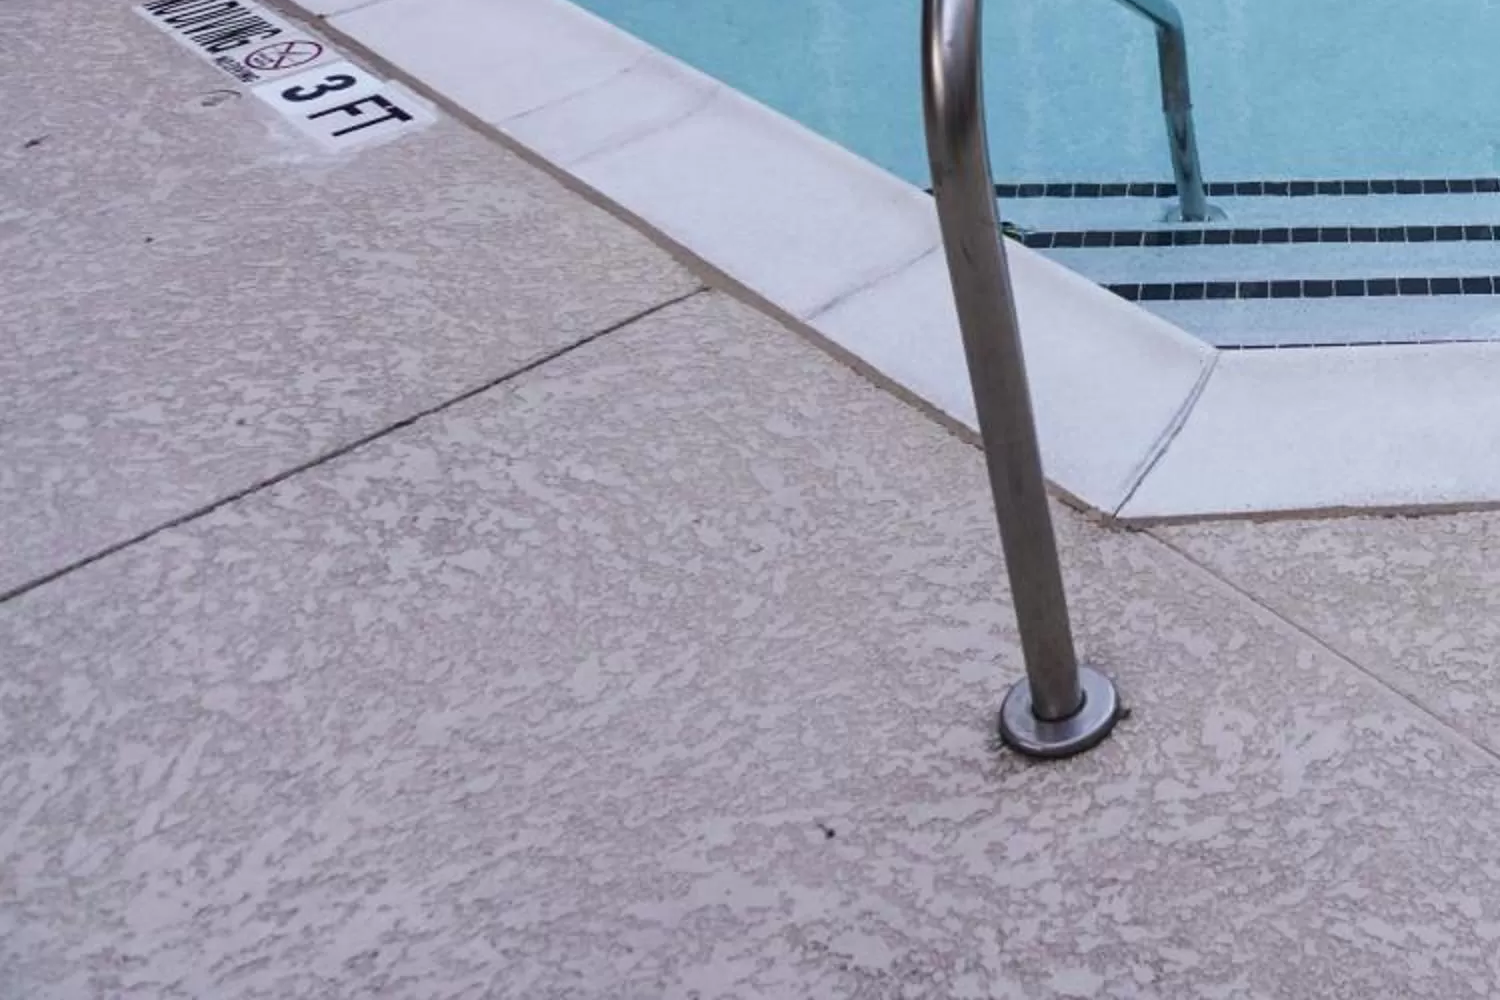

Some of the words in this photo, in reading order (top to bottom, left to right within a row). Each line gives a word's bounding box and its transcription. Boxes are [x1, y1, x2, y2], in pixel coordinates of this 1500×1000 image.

[161, 0, 284, 54] DIVING
[281, 73, 358, 103] 3
[306, 93, 414, 139] FT
